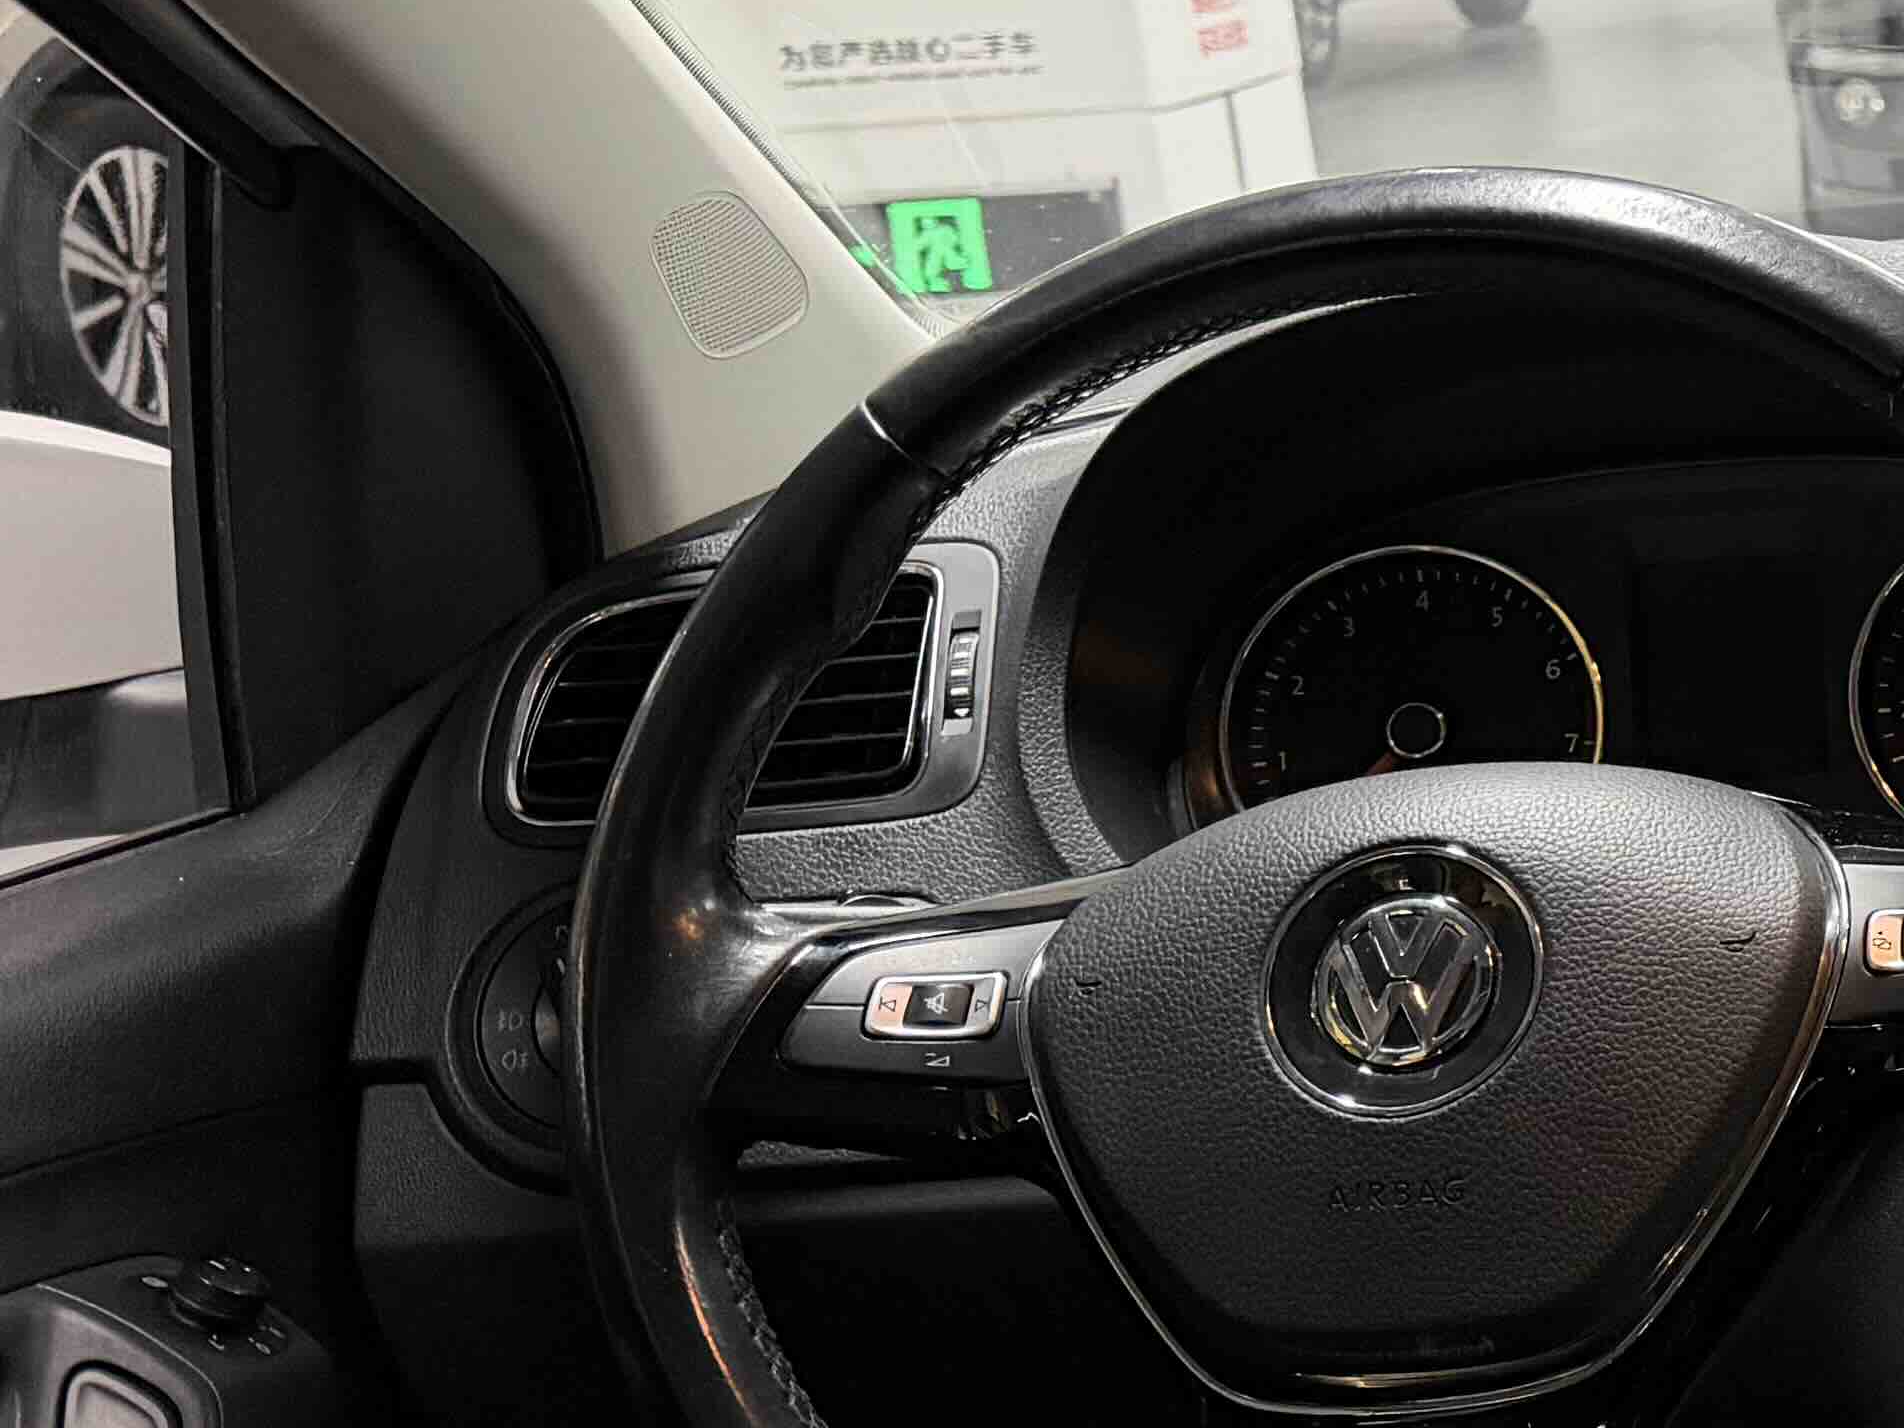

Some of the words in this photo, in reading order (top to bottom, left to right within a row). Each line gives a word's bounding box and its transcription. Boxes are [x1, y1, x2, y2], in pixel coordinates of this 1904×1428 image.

[1415, 591, 1430, 612] 4
[1342, 617, 1356, 638] 3
[1491, 606, 1504, 628] 5
[1546, 658, 1561, 680] 6
[1291, 675, 1305, 696] 2
[1564, 733, 1579, 754] 7
[1279, 751, 1288, 772] 1
[1327, 1177, 1467, 1214] AIRBAG
